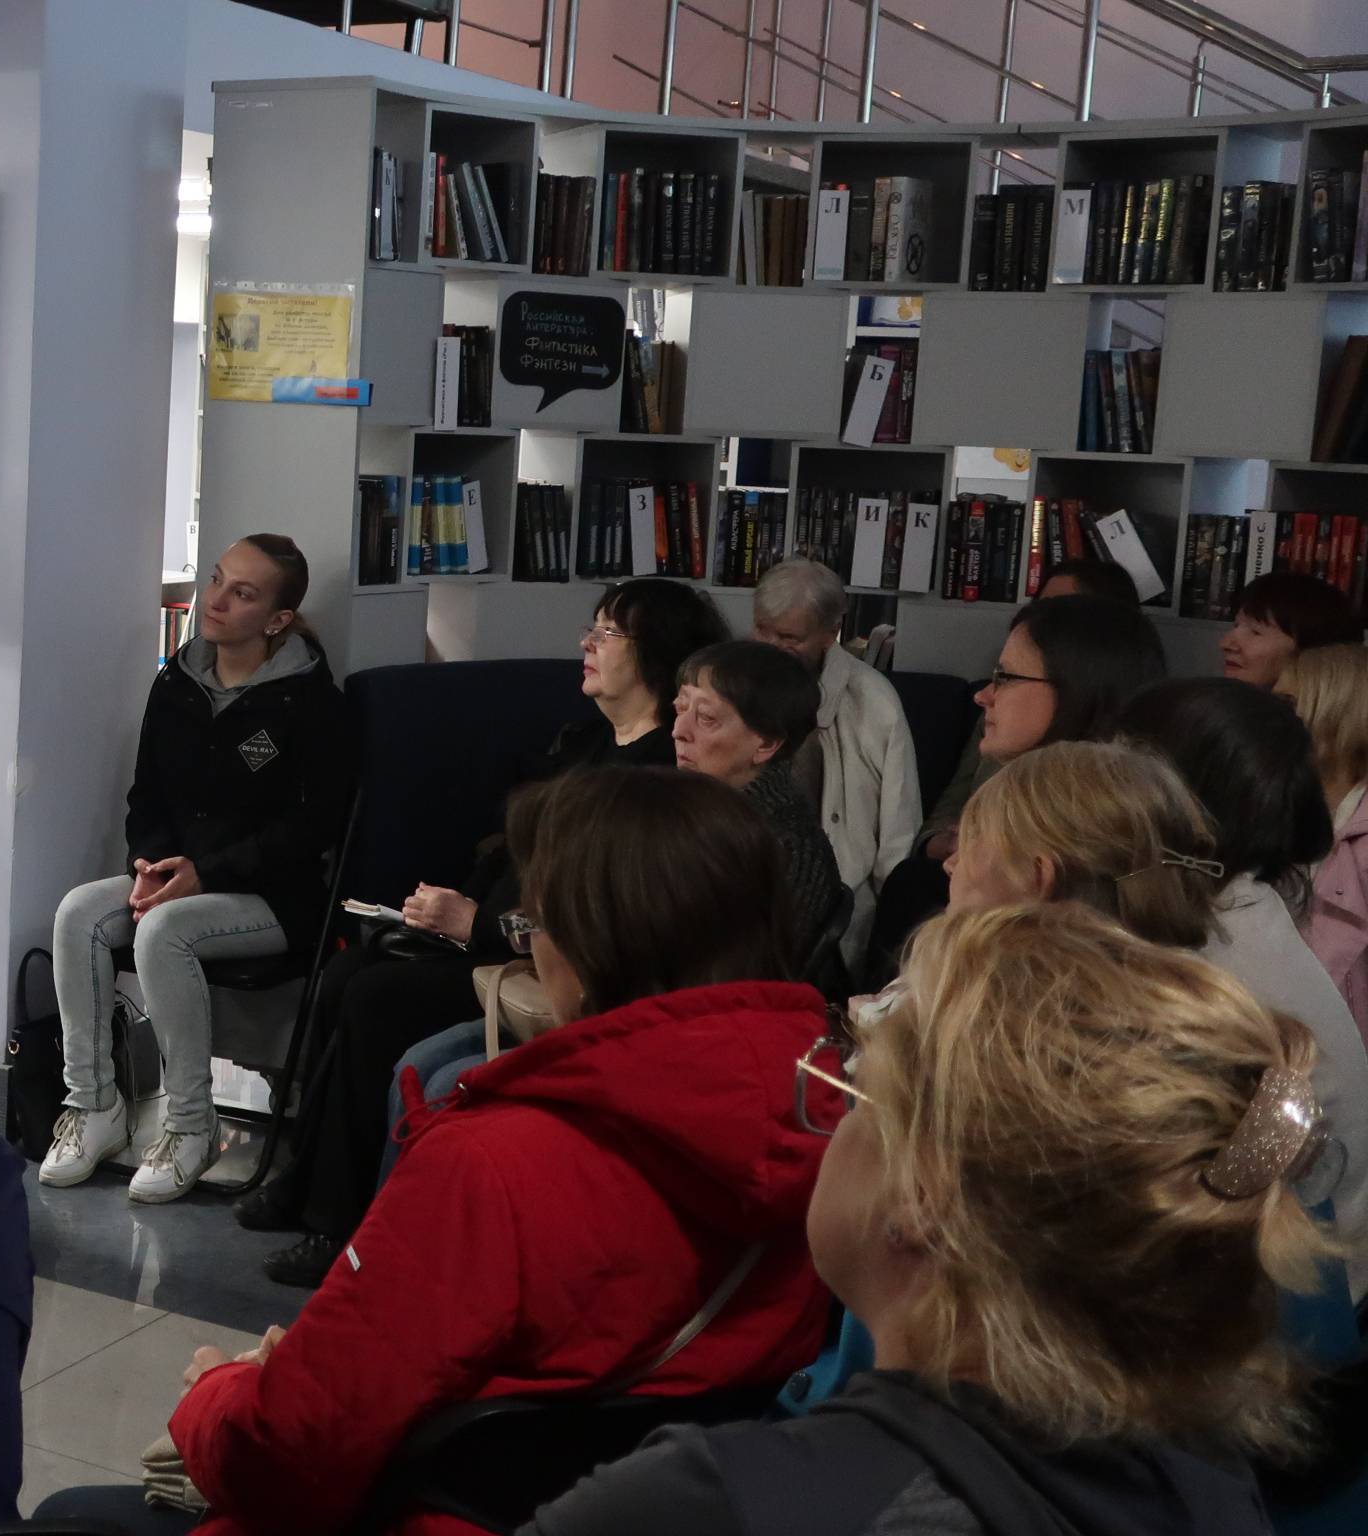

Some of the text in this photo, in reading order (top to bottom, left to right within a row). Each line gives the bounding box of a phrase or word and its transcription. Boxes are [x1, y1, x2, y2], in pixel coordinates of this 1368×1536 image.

[824, 196, 841, 214] Л
[1064, 198, 1085, 215] М
[870, 364, 885, 381] Б
[467, 489, 477, 507] Е
[864, 505, 881, 522] И
[914, 511, 931, 528] К
[1110, 518, 1127, 540] Л
[1254, 537, 1265, 577] ненко
